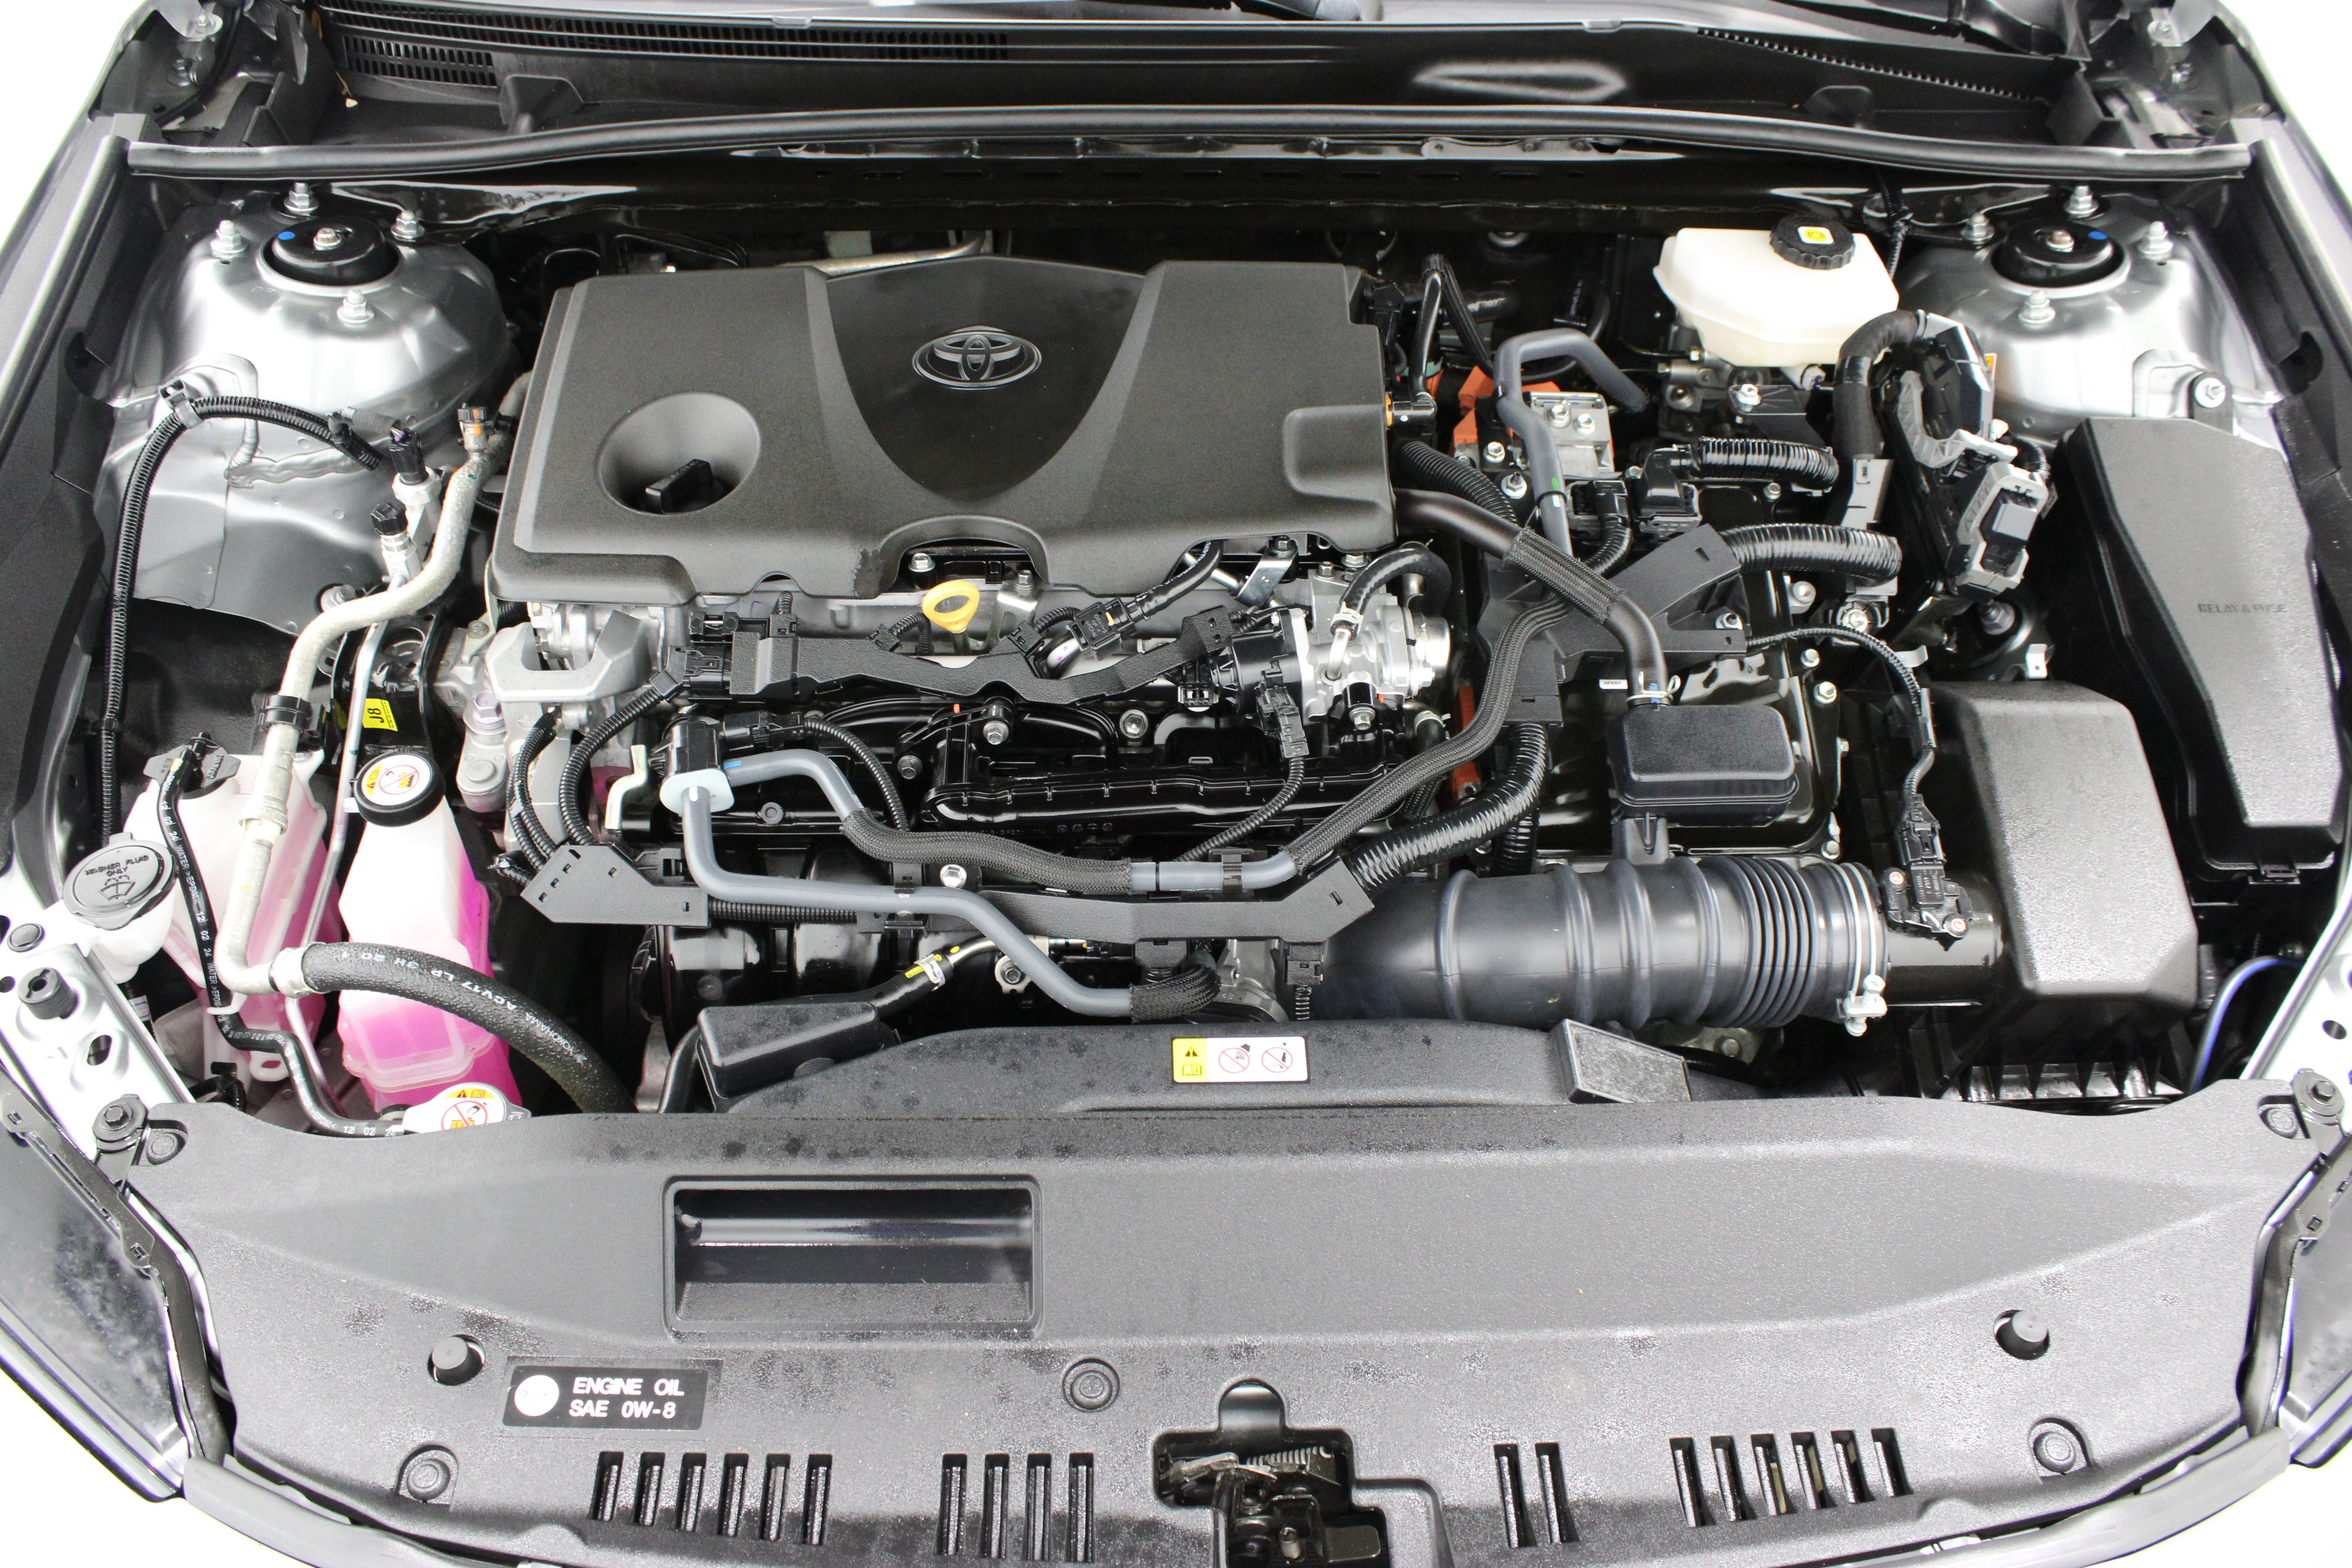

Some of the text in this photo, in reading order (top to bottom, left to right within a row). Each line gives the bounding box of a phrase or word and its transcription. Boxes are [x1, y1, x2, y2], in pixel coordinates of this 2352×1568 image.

[2198, 603, 2238, 613] RELAY
[367, 708, 384, 723] J8
[85, 855, 149, 876] WASHER FLUID
[176, 844, 189, 870] WATER
[107, 866, 128, 876] ONLY
[361, 952, 385, 962] 20
[207, 962, 218, 984] WATER
[430, 969, 455, 982] LP
[461, 982, 517, 1010] ACV17
[525, 1012, 573, 1056] YOKOHAMA
[572, 1376, 685, 1396] ENGINE OIL
[568, 1399, 676, 1419] SAE 0W-8
